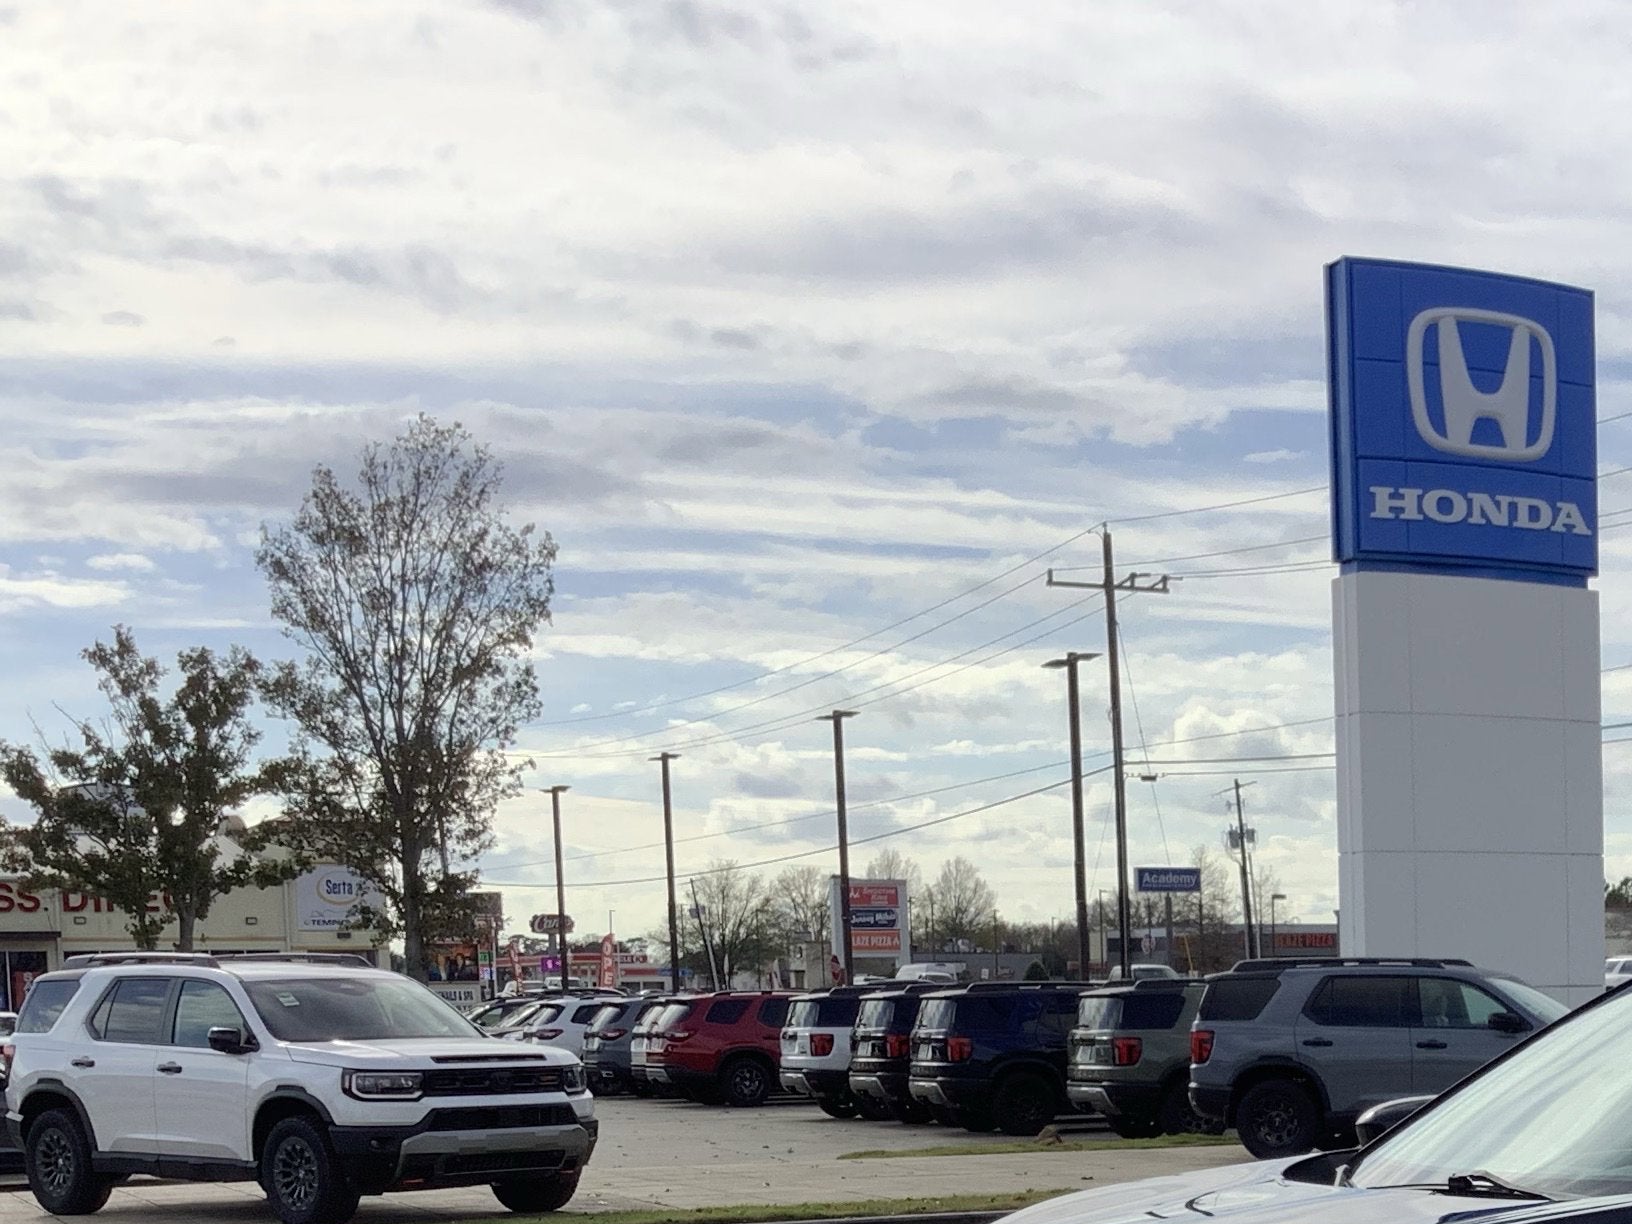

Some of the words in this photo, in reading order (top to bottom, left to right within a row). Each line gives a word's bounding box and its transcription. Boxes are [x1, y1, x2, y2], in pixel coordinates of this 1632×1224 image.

[1369, 486, 1593, 536] HONDA
[326, 879, 354, 895] Serta
[1142, 872, 1197, 887] Academy
